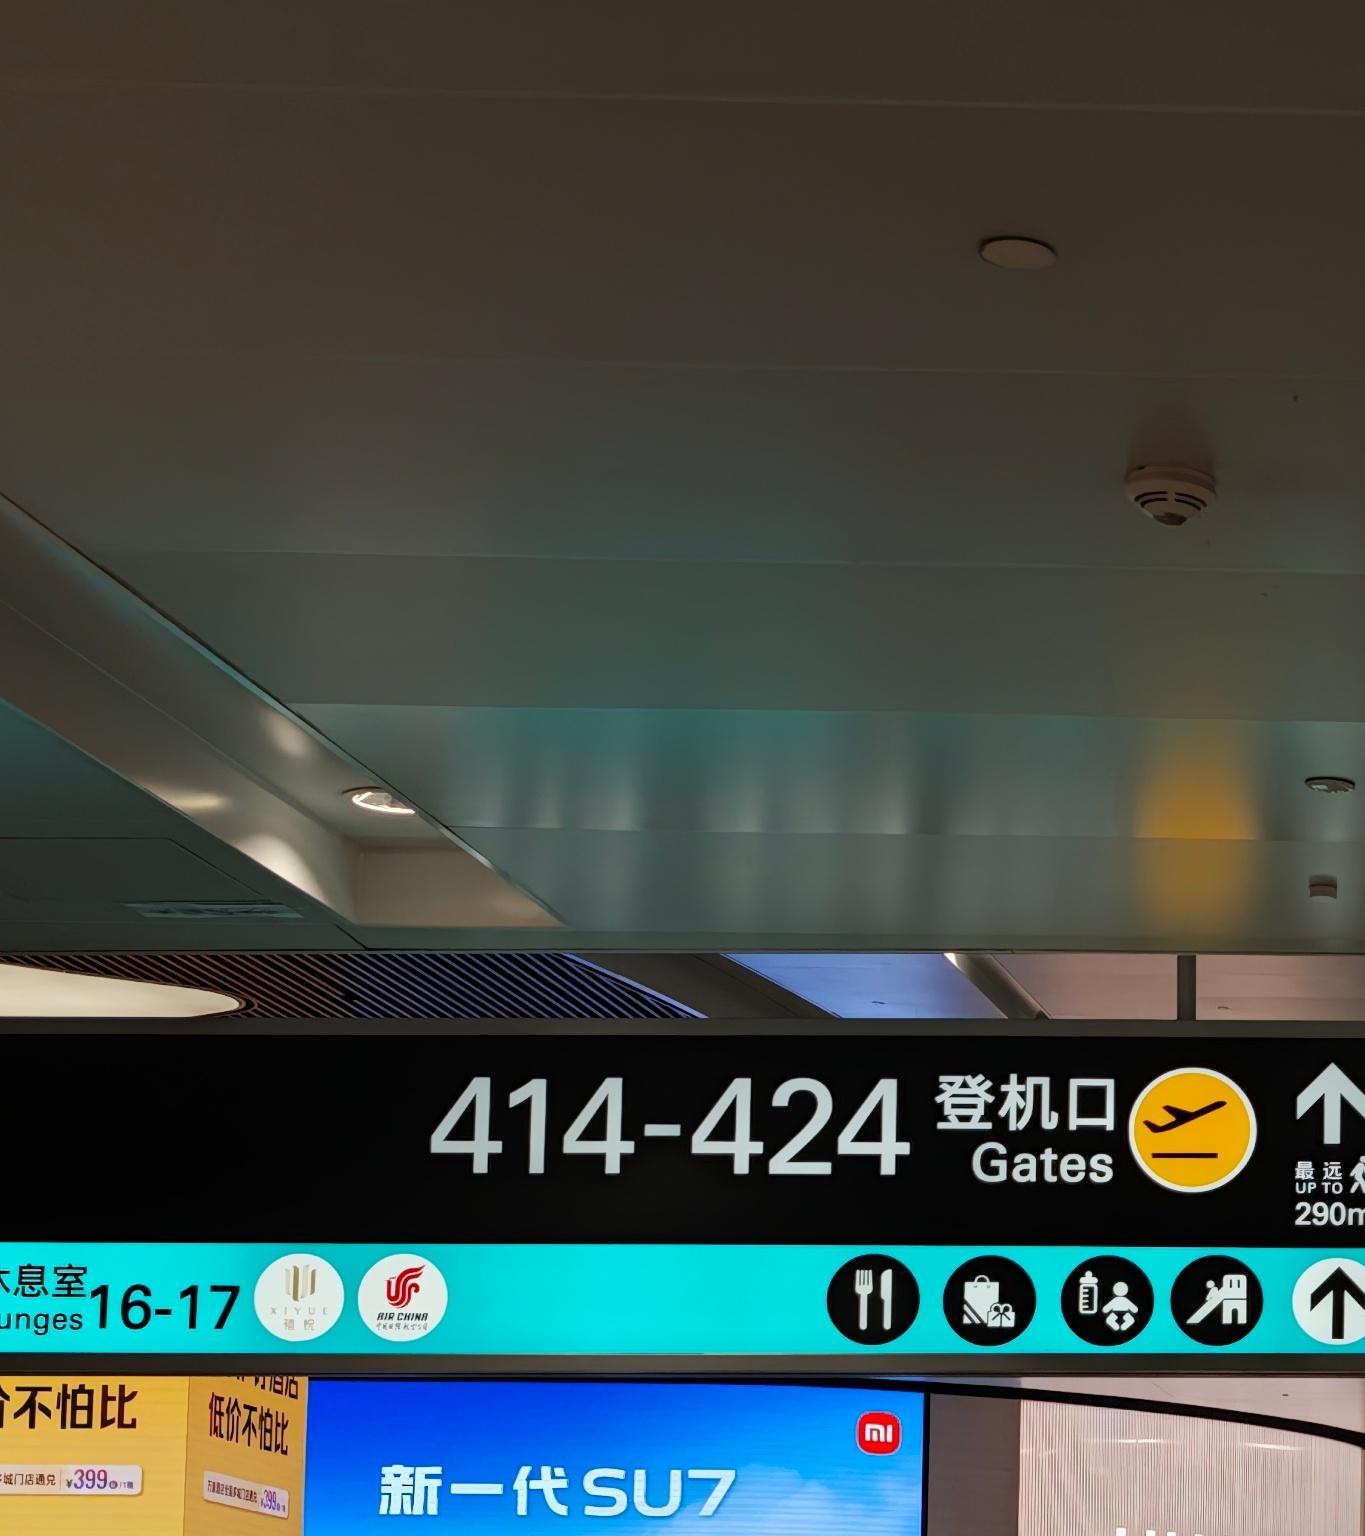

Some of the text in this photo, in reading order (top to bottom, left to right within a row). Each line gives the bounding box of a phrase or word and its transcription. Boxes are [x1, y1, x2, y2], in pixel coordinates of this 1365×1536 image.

[934, 1073, 1115, 1132] 登机口
[430, 1076, 910, 1176] 414-424
[971, 1142, 1113, 1184] Gates
[1294, 1160, 1343, 1181] 最远
[1295, 1181, 1343, 1194] UP TO
[90, 1284, 240, 1330] 16-17
[377, 1312, 429, 1321] AIR CHINA
[208, 1391, 289, 1455] 低价不怕比
